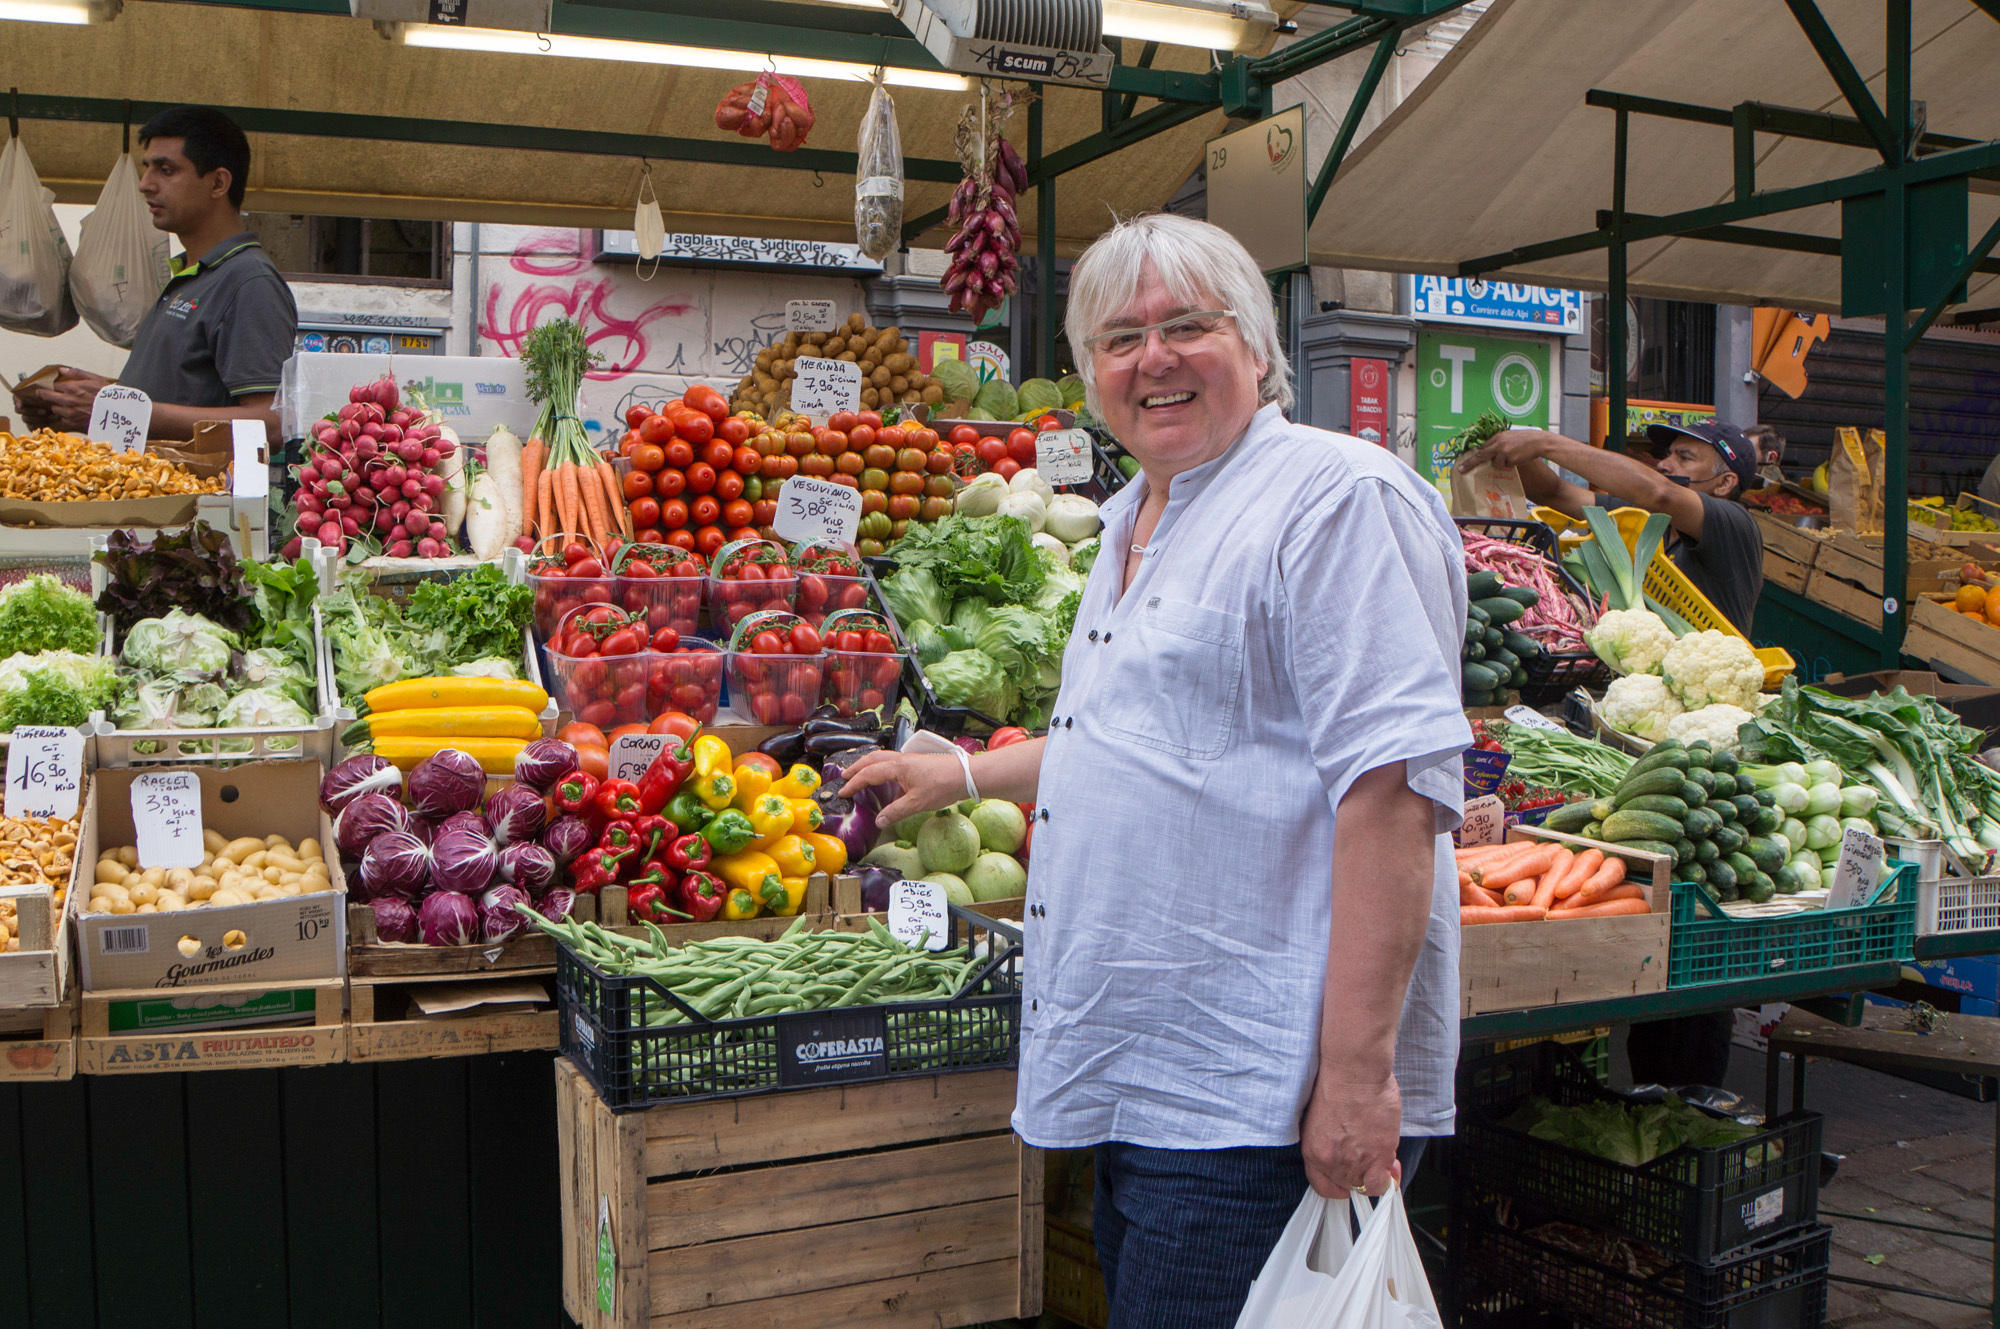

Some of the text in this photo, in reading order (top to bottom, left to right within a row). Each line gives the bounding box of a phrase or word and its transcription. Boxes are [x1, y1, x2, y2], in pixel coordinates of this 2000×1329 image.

[1003, 55, 1048, 72] scum
[1212, 147, 1227, 171] 29
[731, 237, 755, 250] der
[1492, 282, 1575, 308] ADIGE
[1470, 304, 1529, 320] Corriere delle Alpi
[476, 382, 506, 394] Veneto
[804, 377, 833, 394] 7,90
[1439, 344, 1476, 414] T
[1356, 404, 1383, 414] TABACCHI
[1360, 396, 1379, 405] TABAK
[100, 410, 132, 430] 19,90
[792, 480, 852, 500] VESUVIANO
[790, 497, 828, 520] 3,80
[13, 755, 67, 790] 16,90
[146, 794, 179, 814] 3,90
[1462, 814, 1490, 834] 6,90
[900, 896, 932, 912] 5,90
[294, 918, 330, 942] 10 kg
[205, 944, 224, 960] Les
[156, 946, 274, 988] Gourmandes
[107, 1041, 200, 1063] ASTA
[202, 1034, 316, 1053] FRUTTALTEDO
[796, 1037, 884, 1060] COFERASTA
